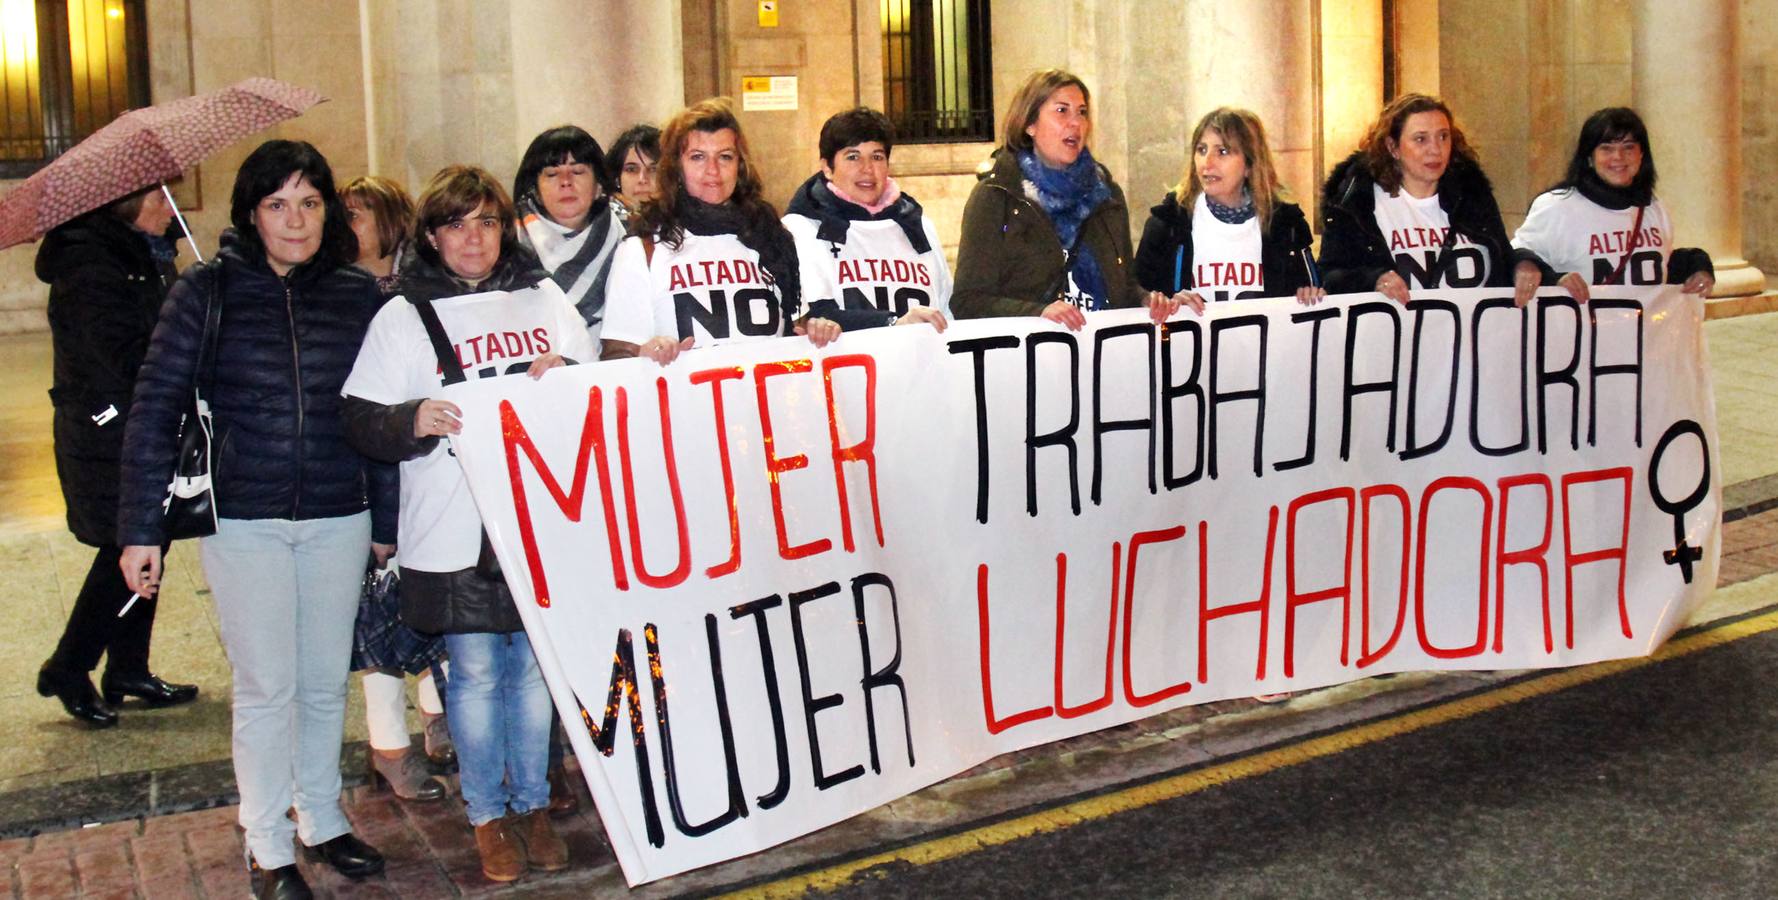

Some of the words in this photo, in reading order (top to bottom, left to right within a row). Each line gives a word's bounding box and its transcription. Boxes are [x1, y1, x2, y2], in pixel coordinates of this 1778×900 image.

[838, 258, 931, 287] ALTADIS
[1592, 250, 1664, 286] NO
[673, 287, 780, 343] NO
[437, 327, 551, 375] LTADIS
[498, 352, 886, 609] MUJER
[947, 297, 1643, 524] TRABAJADORA
[571, 571, 916, 849] MUJER
[978, 466, 1633, 735] LUCHADORA
